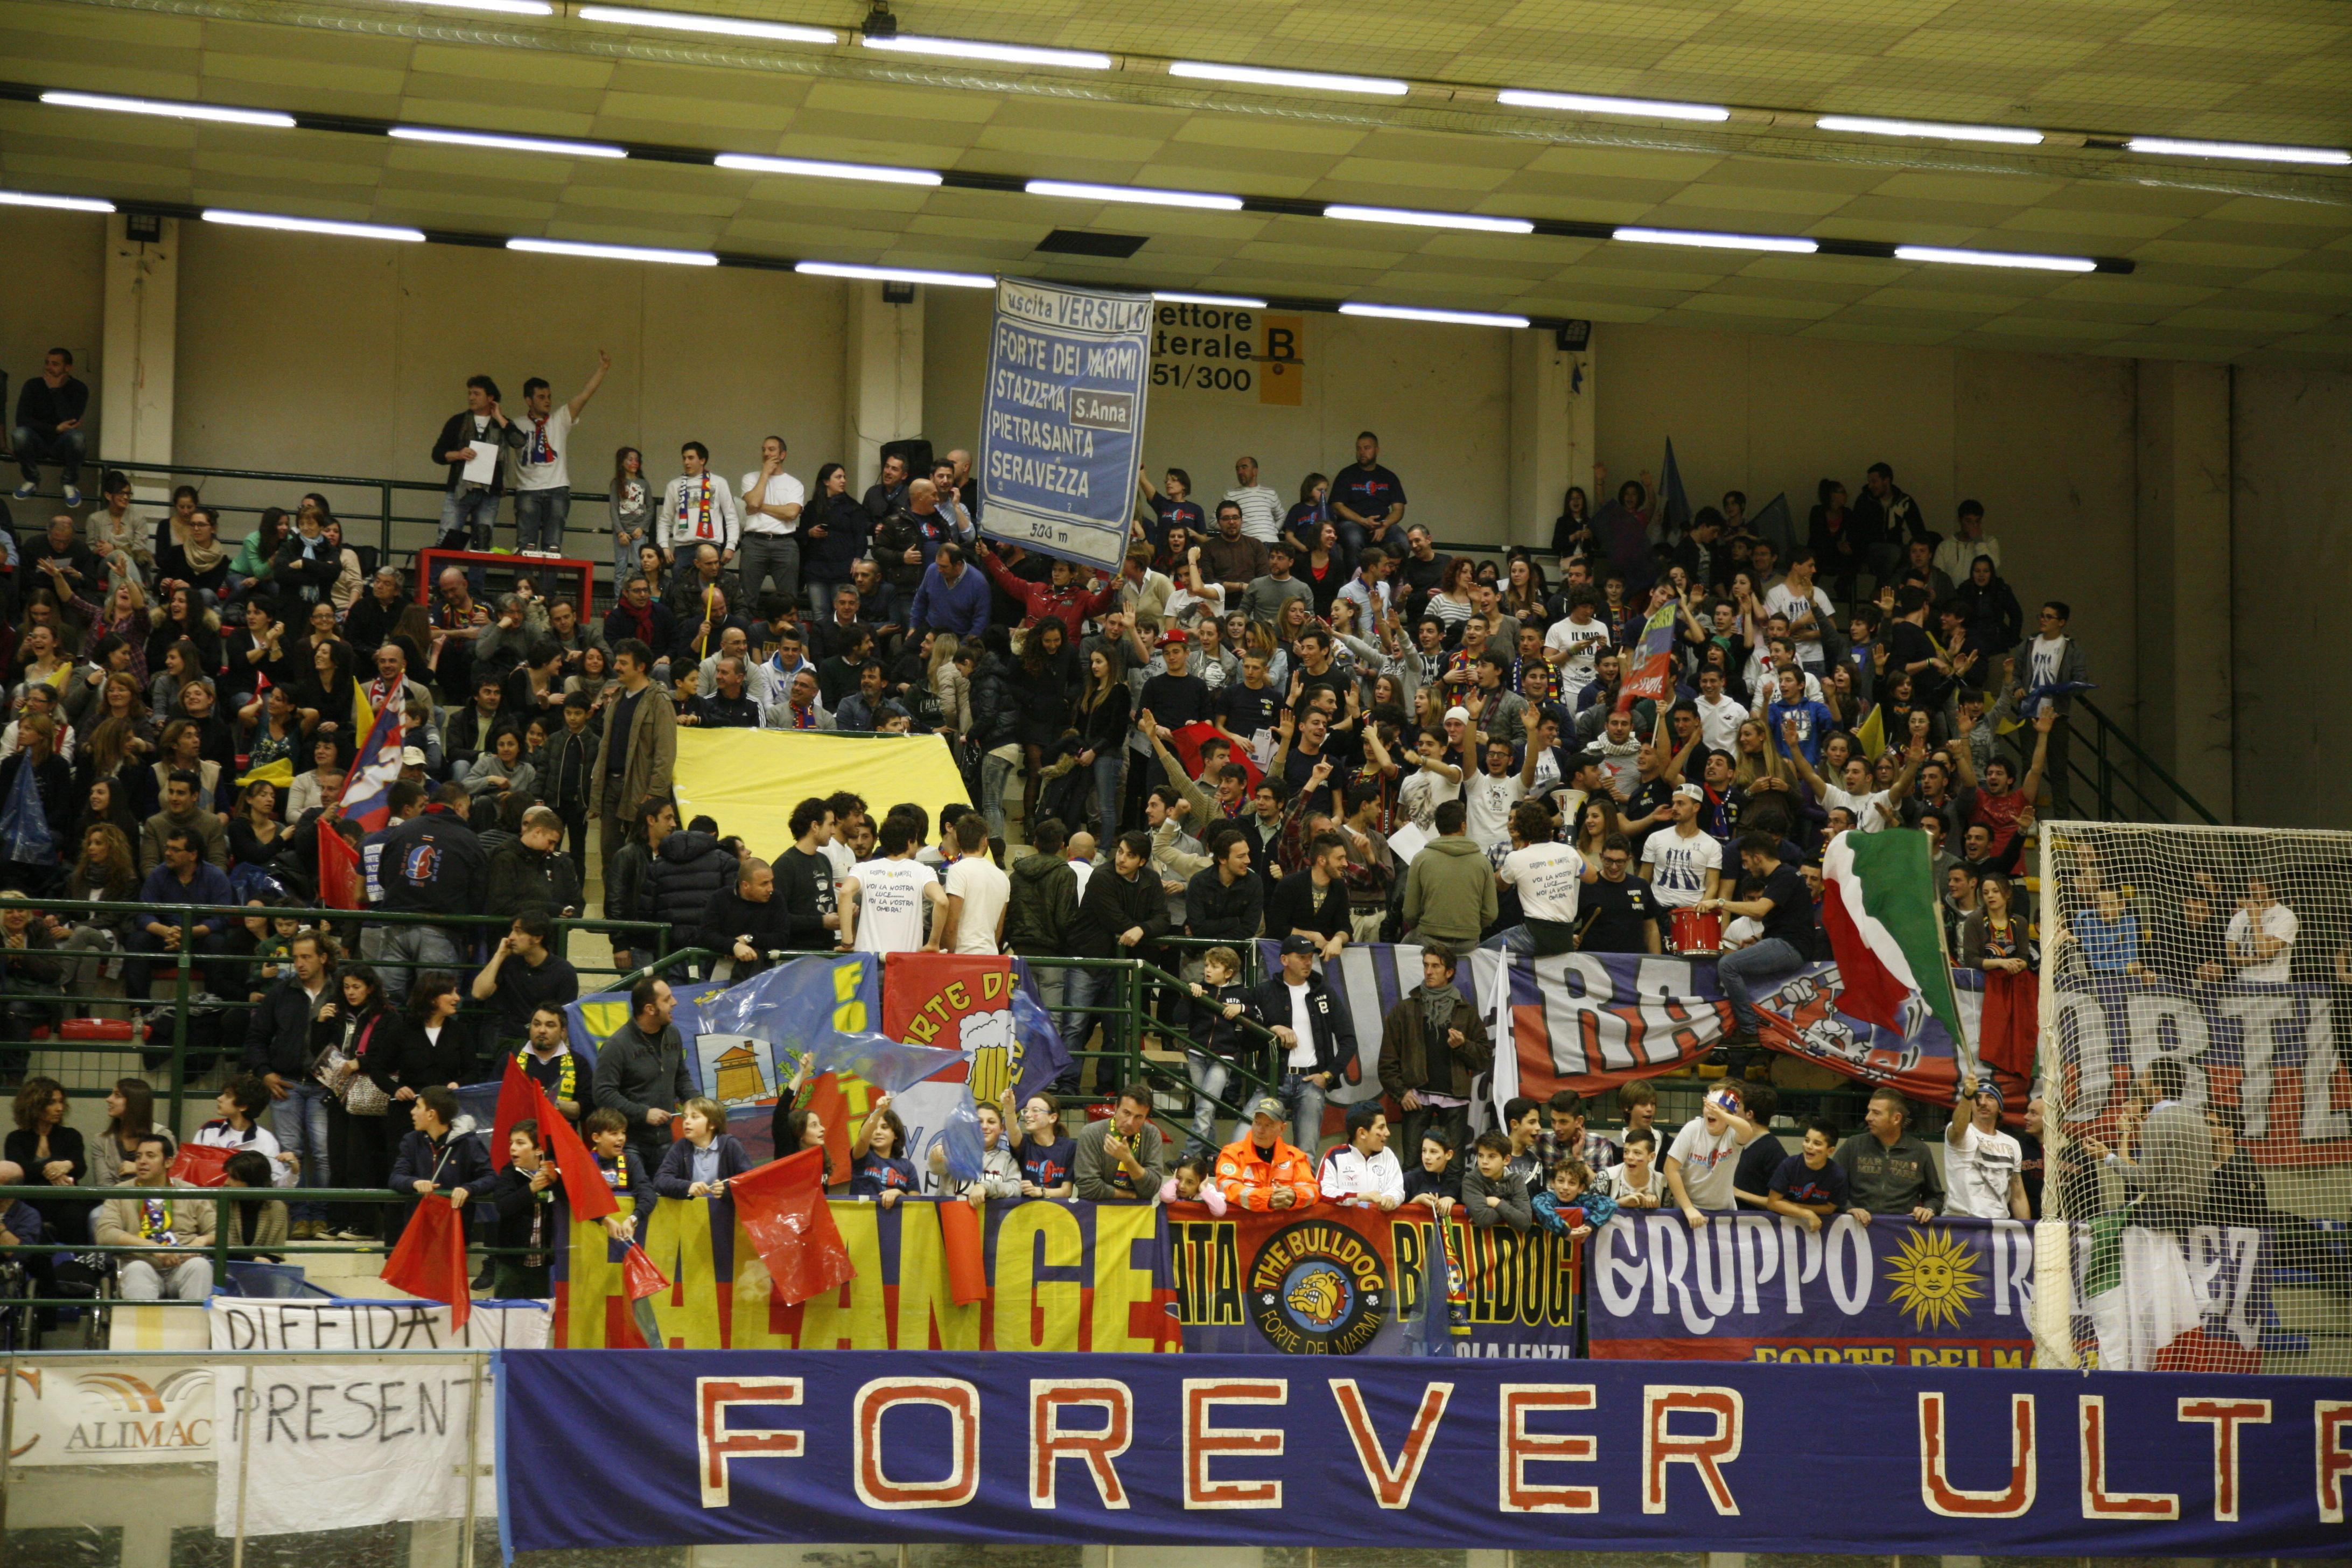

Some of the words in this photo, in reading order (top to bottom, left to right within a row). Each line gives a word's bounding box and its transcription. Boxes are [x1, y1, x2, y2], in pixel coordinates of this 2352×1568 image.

[1008, 293, 1053, 319] uscita
[1153, 303, 1252, 332] ettore
[999, 327, 1047, 370] FORTE
[1053, 343, 1080, 376] DEI
[1088, 348, 1137, 381] MARMI
[1151, 330, 1252, 360] terale
[1268, 327, 1295, 360] B
[996, 368, 1066, 413] STAZZEMA
[1075, 397, 1126, 423] S.Anna
[992, 410, 1094, 458] PIETRASANTA
[991, 450, 1089, 499] SERAVEZZA
[1030, 522, 1053, 538] 500
[1058, 532, 1068, 544] m
[1532, 876, 1543, 884] VOI
[1254, 1241, 1292, 1292] THE
[1286, 1227, 1385, 1291] BULLDOG
[1594, 1213, 1874, 1335] GRUPPO
[1259, 1309, 1301, 1353] FORTE
[1334, 1311, 1382, 1356] MARMI
[64, 1419, 212, 1450] ALIMAC
[696, 1376, 1744, 1516] FOREVER
